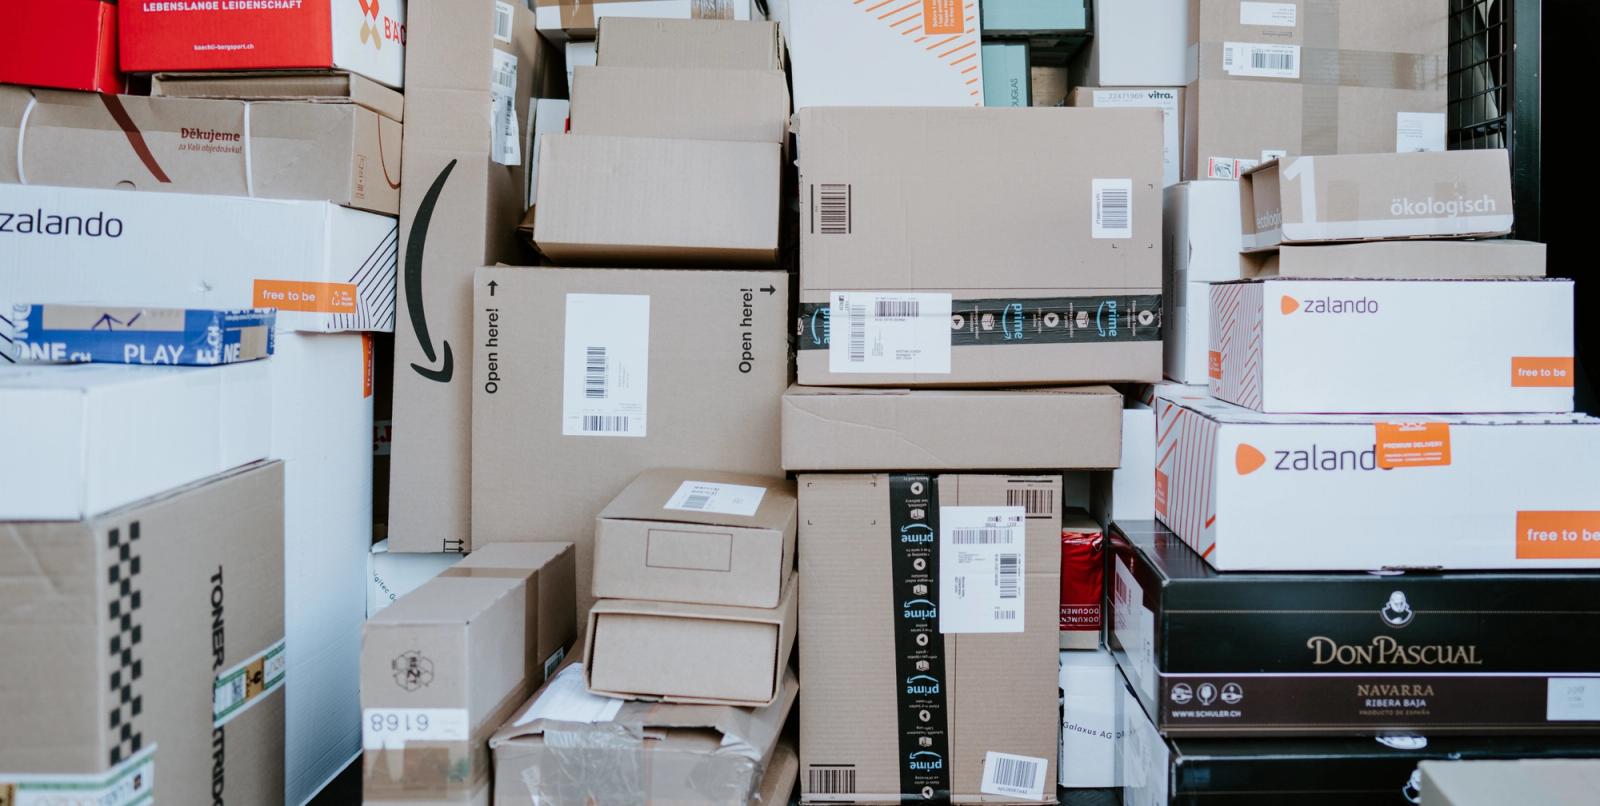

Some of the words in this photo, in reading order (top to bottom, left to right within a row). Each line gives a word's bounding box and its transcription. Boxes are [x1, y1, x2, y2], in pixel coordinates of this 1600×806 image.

[143, 1, 219, 12] LEBENSLANGE
[222, 0, 302, 10] LEIDENSCHAFT
[181, 127, 241, 143] Děkujeme
[1391, 194, 1496, 216] ökologisch
[0, 208, 123, 238] zalando
[262, 289, 285, 300] free
[287, 290, 299, 301] to
[301, 291, 317, 302] be
[739, 287, 754, 328] here!
[1304, 296, 1378, 314] zalando
[485, 307, 500, 349] here!
[1013, 303, 1024, 340] prime
[1108, 300, 1118, 338] prime
[123, 343, 185, 365] PLAY
[738, 329, 754, 374] Open
[484, 351, 500, 395] Open
[1518, 367, 1538, 377] free
[1540, 368, 1551, 377] to
[1553, 368, 1567, 377] be
[1275, 444, 1394, 471] zaland
[901, 531, 934, 545] prime
[1527, 528, 1558, 541] free
[1562, 529, 1578, 541] to
[1582, 528, 1600, 541] be
[211, 565, 224, 671] TONER
[904, 607, 937, 621] prime
[906, 683, 939, 697] prime
[1357, 684, 1434, 696] NAVARRA
[1365, 699, 1401, 707] RIBERA
[1403, 699, 1427, 708] BAJA
[1171, 710, 1242, 718] WWW.SCHULER.CH
[1063, 721, 1098, 736] Galaxus
[1100, 730, 1113, 740] AG
[910, 758, 942, 772] prime
